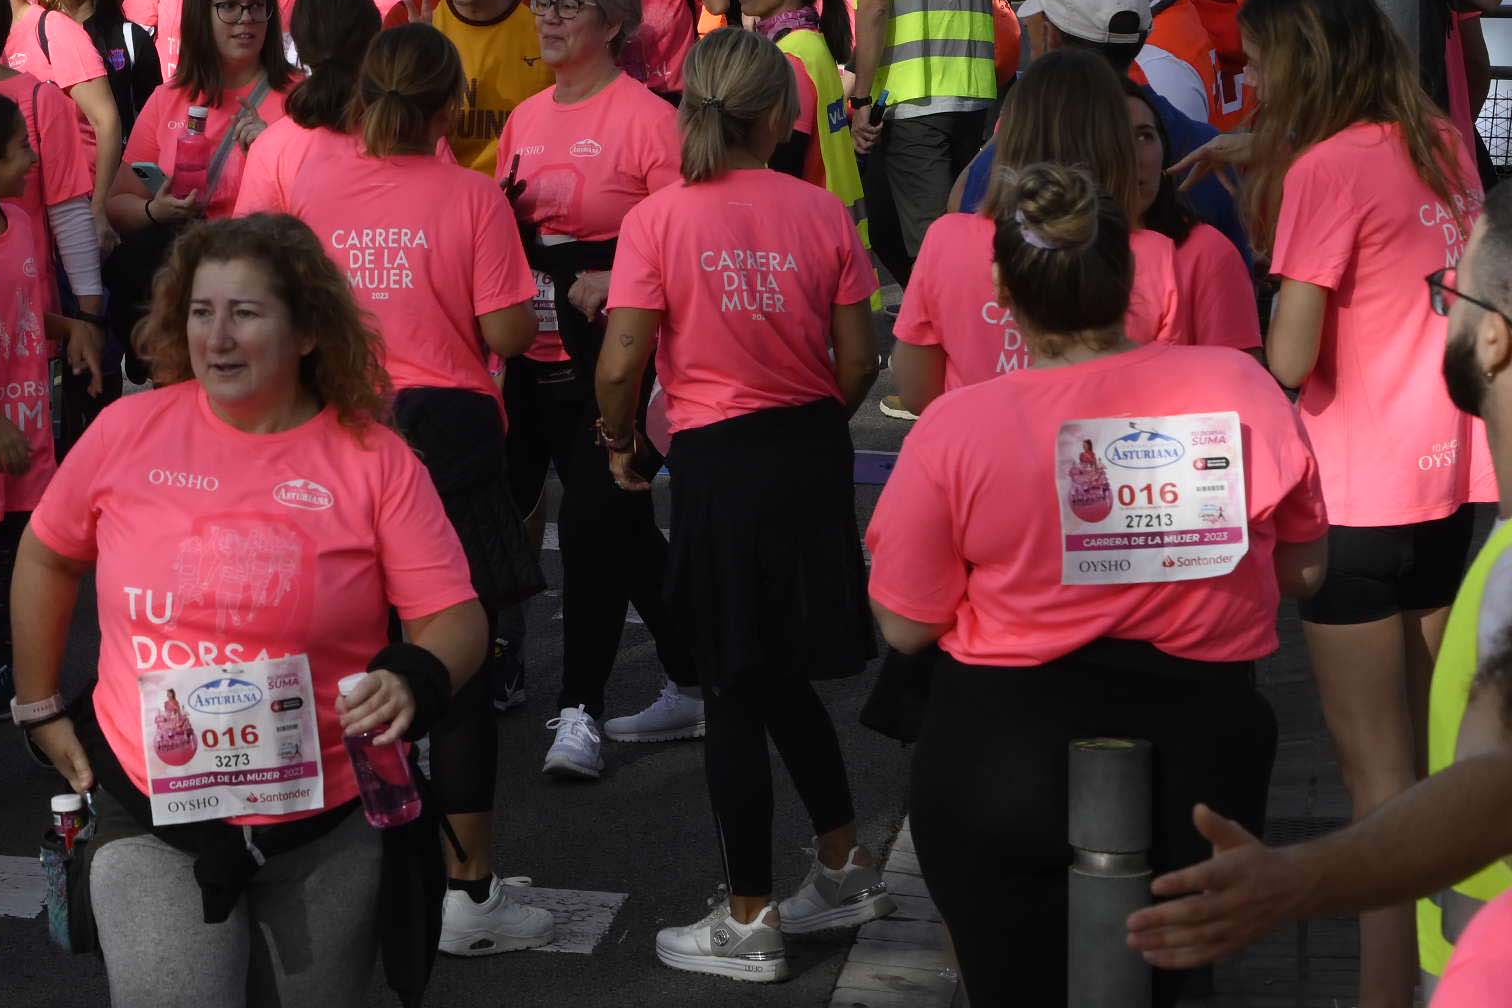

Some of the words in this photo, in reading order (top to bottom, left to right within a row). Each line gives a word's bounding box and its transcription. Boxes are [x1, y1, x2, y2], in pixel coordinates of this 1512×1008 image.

[331, 228, 429, 250] CARRERA
[349, 250, 375, 269] DE
[384, 249, 409, 269] LA
[700, 248, 799, 272] CARRERA
[347, 269, 415, 289] MUJER
[756, 271, 780, 292] LA
[1191, 436, 1227, 447] SUMA
[1111, 445, 1180, 462] ASTURIANA
[148, 468, 219, 492] OYSHO
[1118, 482, 1179, 506] 016
[1125, 513, 1174, 529] 27213
[1083, 538, 1129, 548] CARRERA
[1131, 537, 1144, 546] DE
[1147, 535, 1161, 545] LA
[1163, 534, 1200, 543] MUJER
[1203, 532, 1228, 542] 2023
[1078, 559, 1131, 574] OYSHO
[1176, 553, 1234, 569] Santander
[124, 586, 174, 625] TU
[267, 677, 301, 690] SUMA
[192, 689, 259, 708] ASTURIANA
[201, 723, 260, 749] 016
[215, 753, 251, 768] 3273
[168, 775, 216, 790] CARRERA
[217, 774, 230, 784] DE
[231, 773, 244, 783] LA
[246, 769, 280, 782] MUJER
[167, 794, 219, 813] OYSHO
[259, 786, 311, 804] Santander
